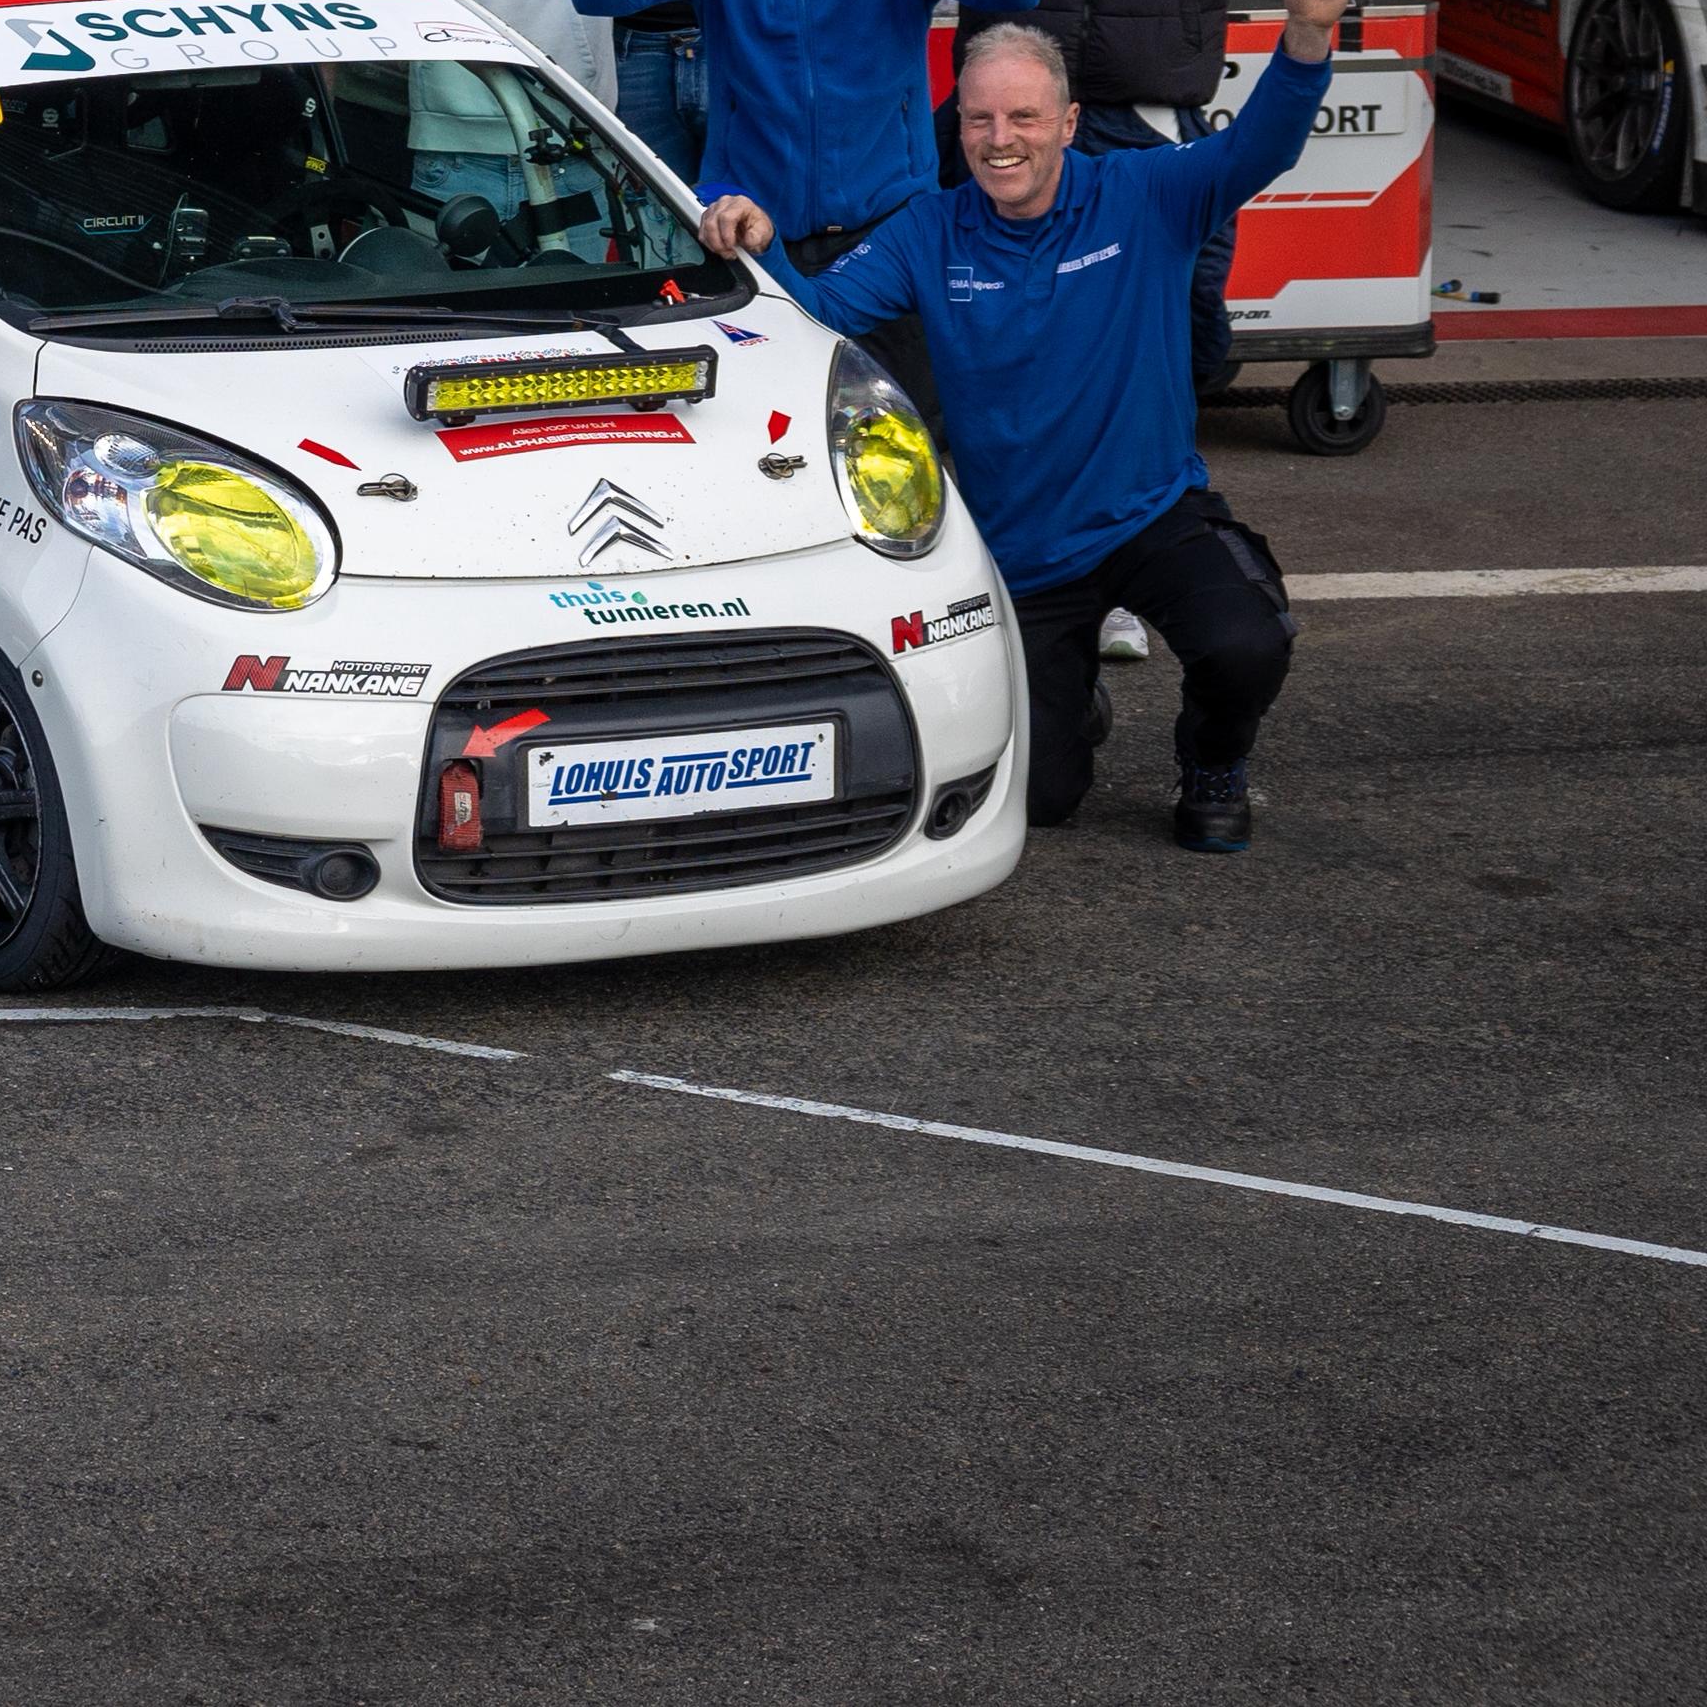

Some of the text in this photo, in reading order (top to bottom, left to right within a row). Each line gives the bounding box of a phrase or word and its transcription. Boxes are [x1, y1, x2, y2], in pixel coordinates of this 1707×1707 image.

[75, 2, 379, 42] SCHYNS
[110, 35, 399, 70] GROUP
[83, 215, 136, 229] CIRCUIT
[1226, 309, 1271, 322] p-on
[512, 422, 541, 437] Alles
[542, 422, 569, 433] voor
[570, 421, 589, 430] uw
[459, 430, 684, 456] www.ALPHASIERBESTRATING.nl
[8, 503, 48, 546] PAS
[549, 586, 627, 609] thuis
[584, 594, 751, 625] tuinieren.nl
[948, 594, 990, 614] MOTORSPORT
[927, 604, 994, 641] NANKANG
[332, 661, 431, 677] MOTORSPORT
[284, 670, 427, 696] NANKANG
[552, 742, 814, 798] LOHUIS AUTO SPORT
